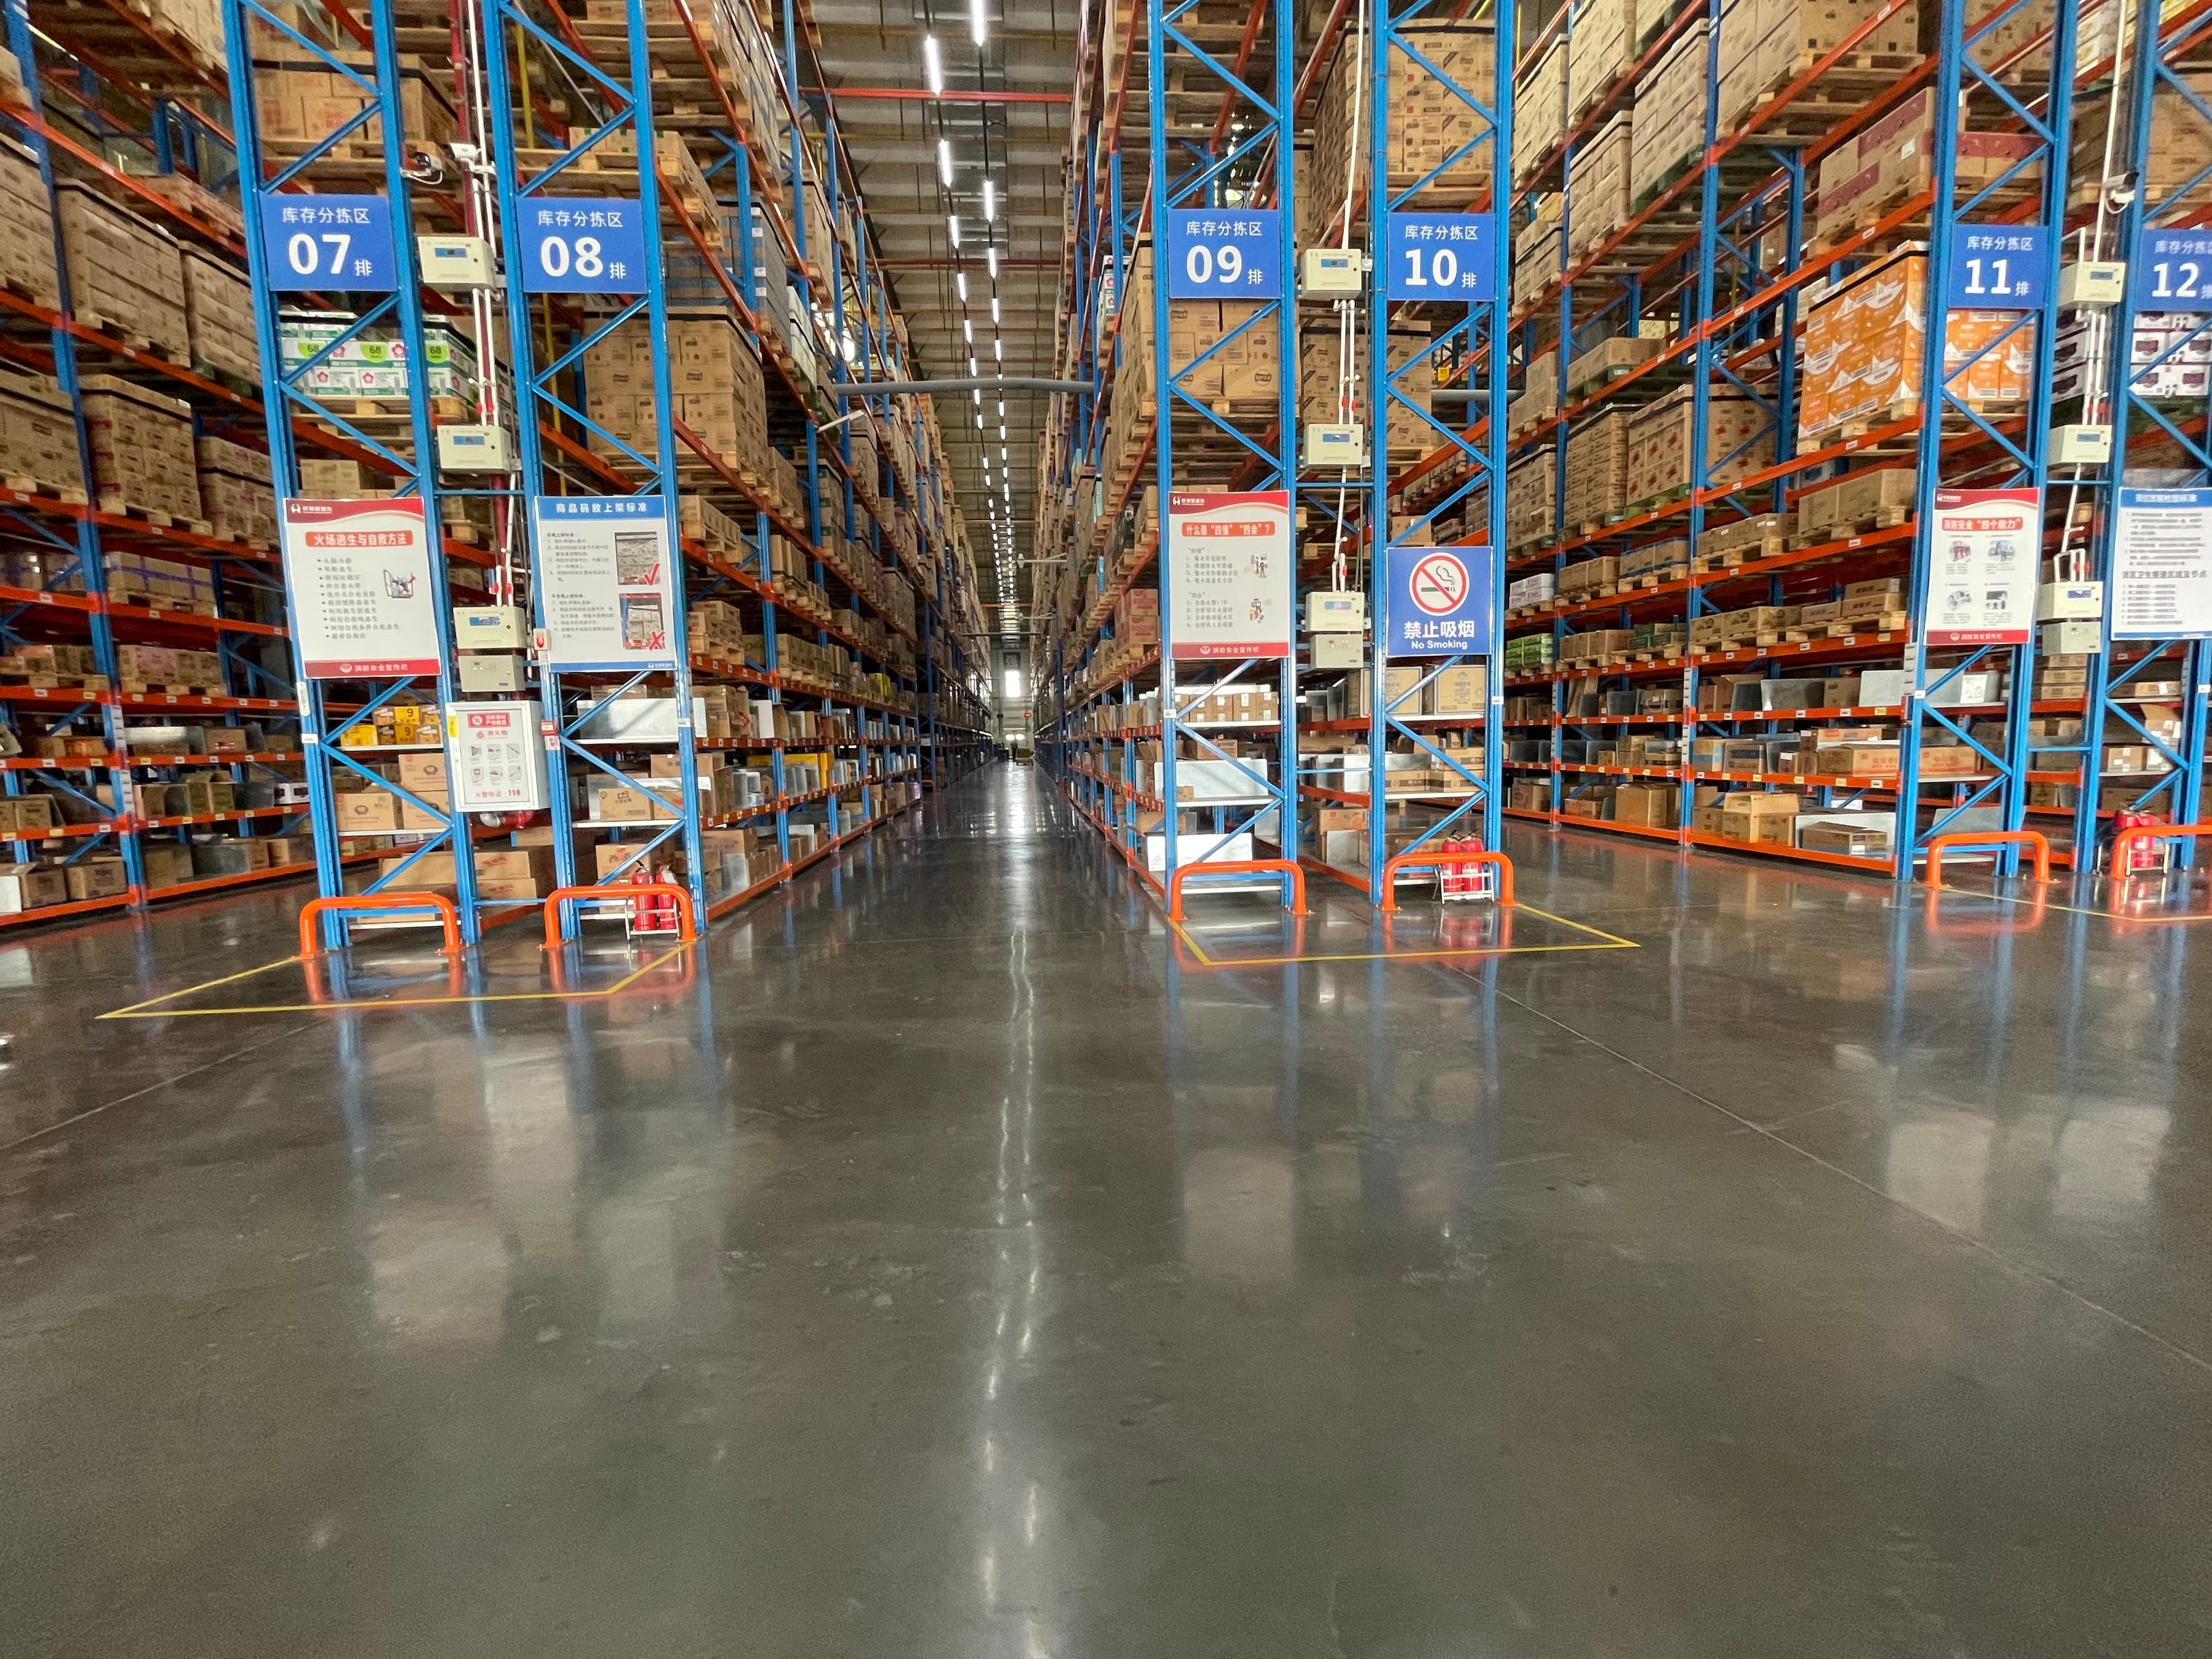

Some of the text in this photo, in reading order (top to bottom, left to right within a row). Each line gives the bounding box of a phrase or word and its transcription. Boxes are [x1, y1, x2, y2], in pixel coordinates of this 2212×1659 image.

[282, 206, 370, 225] 库存分拣区
[537, 210, 624, 228] 库存分拣区
[1186, 221, 1263, 237] 库存分拣区
[1404, 225, 1478, 241] 库存分拣区
[1966, 235, 2033, 252] 库存分拣区
[288, 233, 373, 276] 07 排
[540, 236, 626, 279] 08 排
[1187, 245, 1263, 285] 09 排
[1406, 248, 1476, 288] 10 排
[1965, 259, 2029, 297] 11 排
[2152, 263, 2199, 297] 12
[369, 346, 381, 354] 68
[430, 346, 441, 354] 68
[556, 502, 647, 514] 商品码放上架标准
[313, 533, 407, 547] 火场逃生与自救方法
[1404, 620, 1475, 639] 禁止吸烟
[1411, 639, 1468, 650] No Smoking
[354, 664, 408, 672] 消防安全宣传栏
[407, 708, 414, 717] 9
[405, 726, 411, 736] 9
